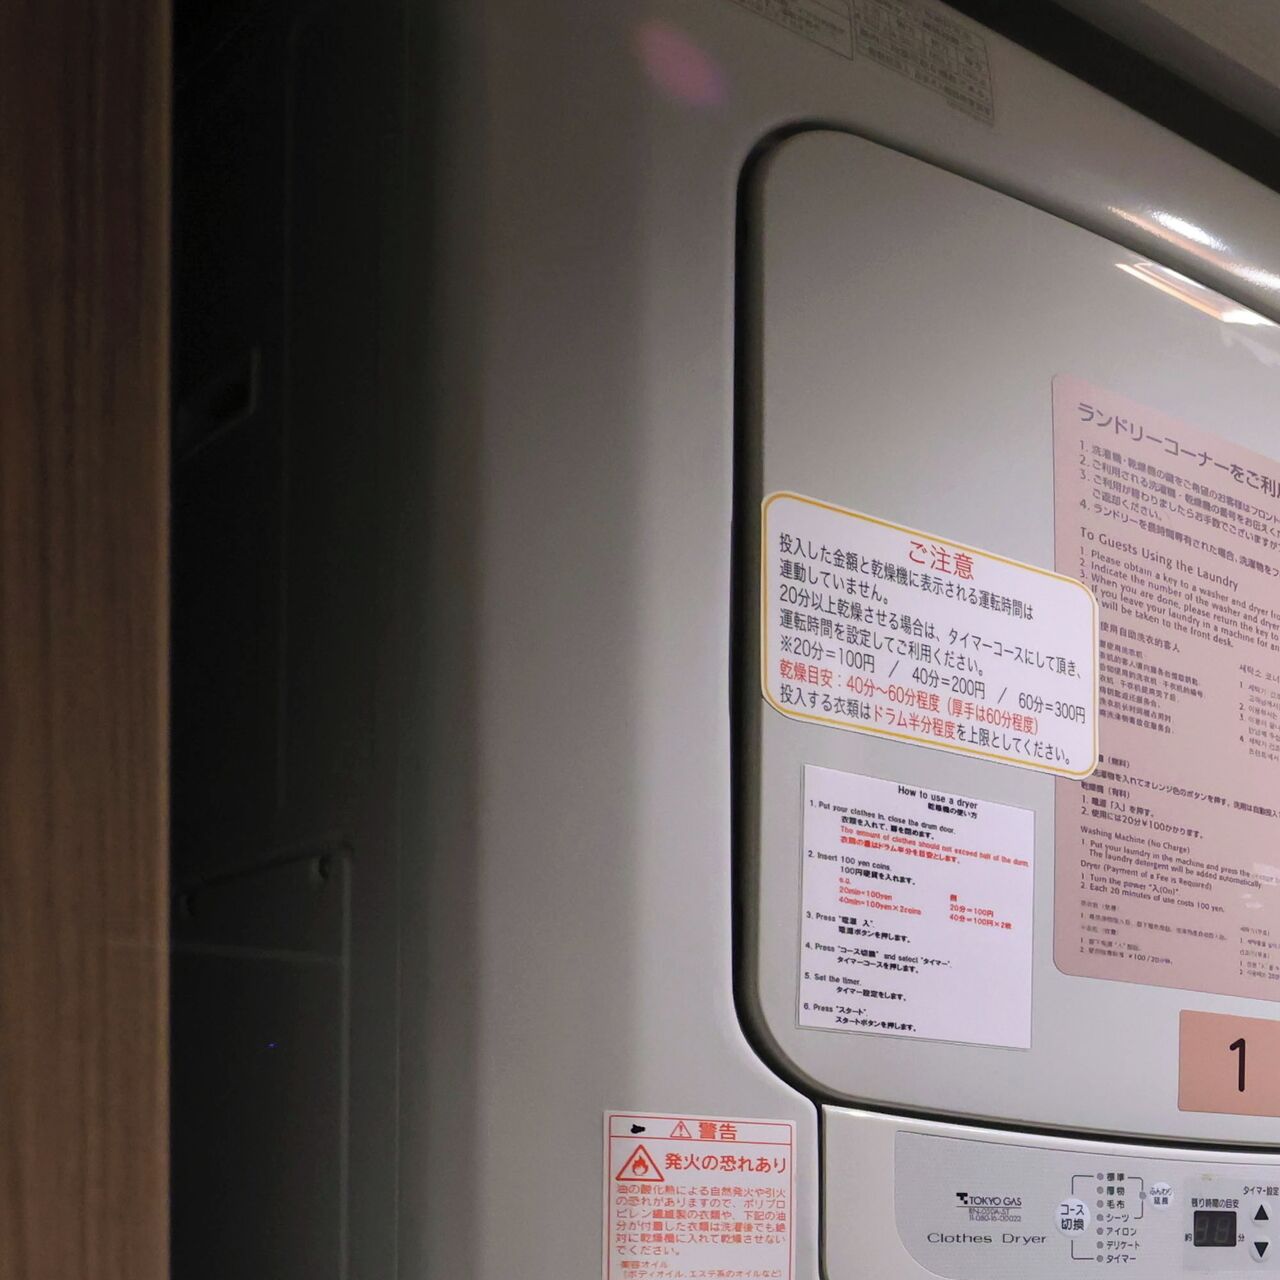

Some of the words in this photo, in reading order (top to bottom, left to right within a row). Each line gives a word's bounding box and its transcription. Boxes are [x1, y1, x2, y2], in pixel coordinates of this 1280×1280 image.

[909, 540, 974, 580] ご注意
[1080, 527, 1094, 540] To
[1099, 534, 1137, 555] Guests
[1142, 548, 1172, 569] Using
[1177, 560, 1193, 574] the
[1198, 568, 1238, 591] Laundry
[780, 533, 1033, 620] 投入した金額と乾燥機に表示される運転時間は
[780, 559, 889, 604] 連動していません。
[1091, 550, 1120, 566] Please
[1124, 562, 1152, 576] obtain
[1163, 573, 1177, 586] key
[1199, 587, 1228, 602] washer
[1232, 599, 1246, 608] and
[1249, 604, 1268, 616] dryer
[1091, 562, 1127, 580] Indicate
[1131, 574, 1145, 585] the
[1148, 581, 1181, 597] number
[1212, 602, 1240, 617] washer
[1243, 613, 1258, 623] and
[1261, 618, 1279, 631] dryer
[1091, 573, 1117, 587] When
[1121, 584, 1136, 594] you
[1140, 591, 1153, 600] are
[1184, 605, 1210, 618] please
[1214, 614, 1237, 627] return
[1240, 621, 1252, 632] the
[1256, 625, 1268, 639] key
[1101, 589, 1117, 600] you
[1121, 592, 1144, 608] leave
[1147, 603, 1166, 615] your
[1169, 608, 1200, 627] laundry
[1221, 627, 1254, 644] machine
[1102, 601, 1118, 611] will
[1135, 611, 1159, 624] taken
[1174, 622, 1187, 632] the
[1191, 627, 1210, 640] front
[780, 584, 1081, 679] 20分以上乾燥させる場合は、タイマーコースにして頂き、
[780, 608, 984, 677] 運転時間を設定してご利用ください。
[780, 683, 1071, 765] 投入する衣類はドラム半分程度を上限としてください。
[898, 785, 916, 796] How
[920, 790, 927, 799] to
[931, 794, 945, 803] use
[957, 799, 978, 809] dryer
[819, 801, 830, 809] Put
[888, 816, 905, 824] close
[1080, 826, 1112, 840] Washing
[1115, 833, 1145, 844] Machine
[818, 852, 837, 861] Insert
[841, 856, 855, 864] 100
[816, 912, 835, 921] Press
[815, 943, 835, 952] Press
[813, 1004, 833, 1012] Press
[1230, 1038, 1245, 1092] 1
[699, 1122, 737, 1140] 警告
[665, 1153, 786, 1173] 発火の恐れあり
[1106, 1173, 1125, 1182] 標準
[969, 1196, 1000, 1206] TOKYO
[1003, 1197, 1022, 1206] GAS
[1061, 1204, 1084, 1216] コース
[1106, 1200, 1125, 1209] 毛布
[1191, 1198, 1239, 1209] 残り時間の目安
[1061, 1218, 1085, 1231] 切換
[1106, 1214, 1129, 1222] シーツ
[927, 1233, 992, 1244] Clothes
[1002, 1233, 1047, 1244] Dryer
[1106, 1227, 1137, 1236] アイロン
[1106, 1241, 1140, 1250] デリケート
[1106, 1255, 1136, 1263] タイマー
